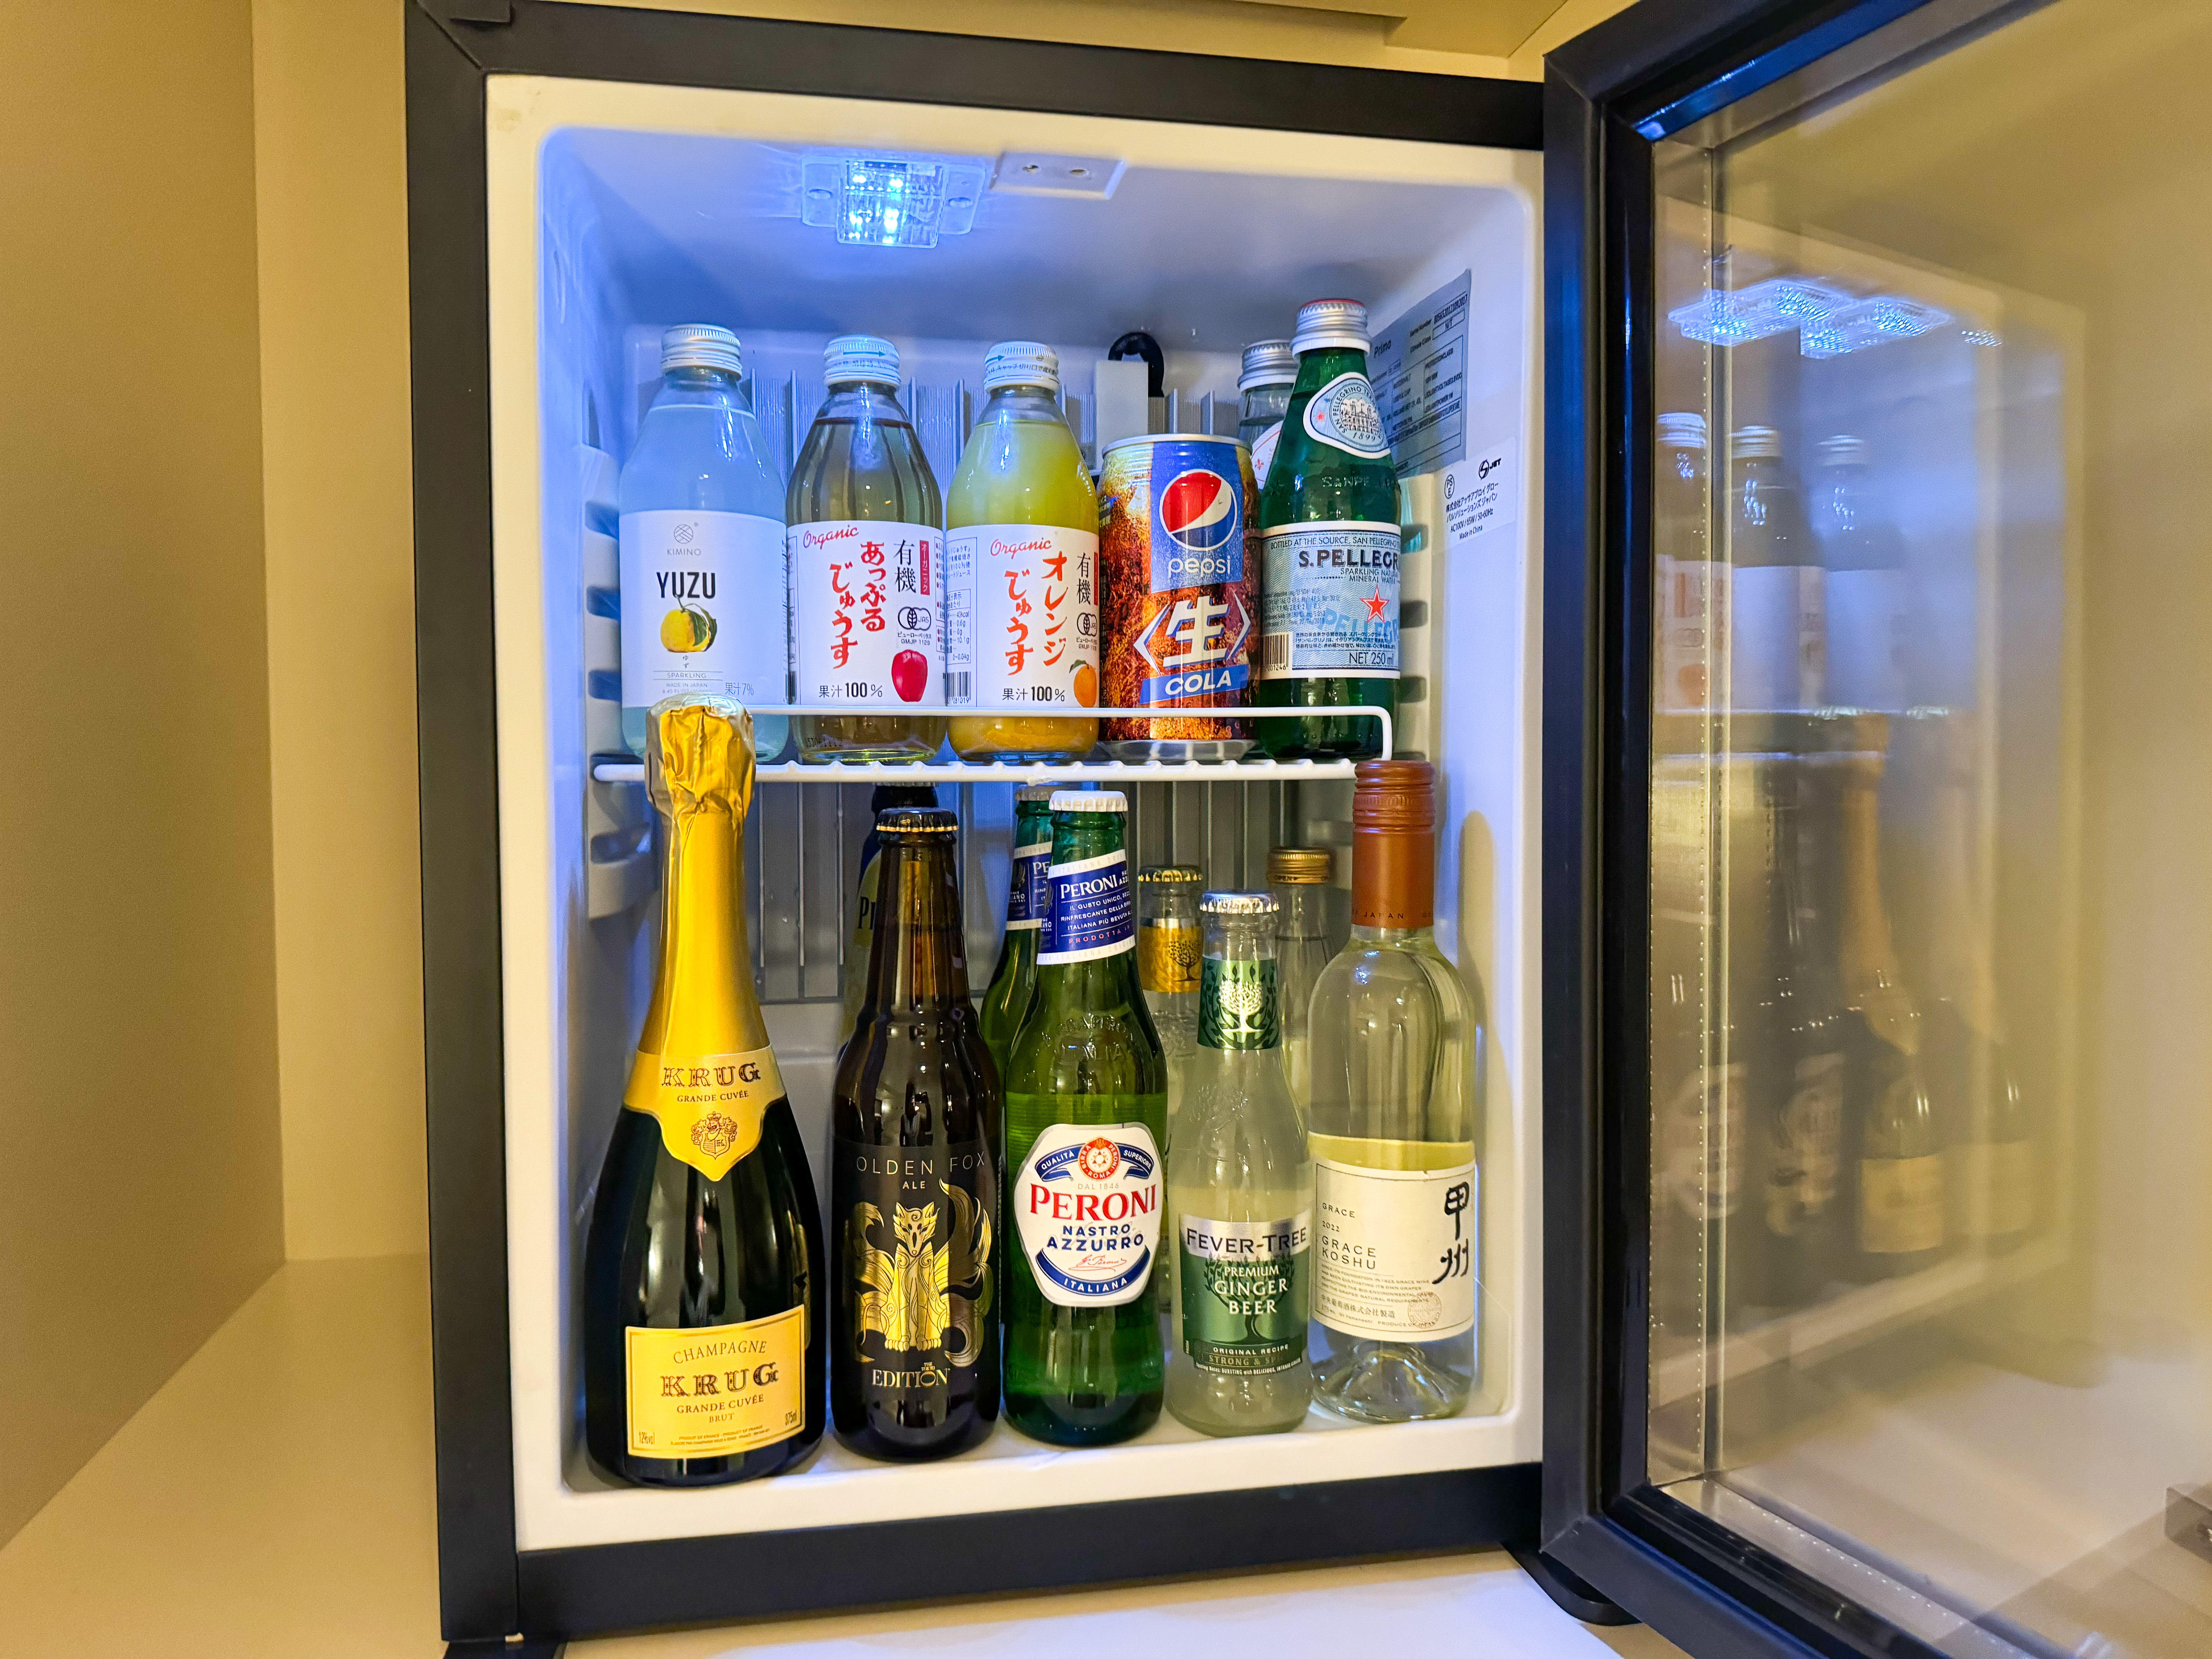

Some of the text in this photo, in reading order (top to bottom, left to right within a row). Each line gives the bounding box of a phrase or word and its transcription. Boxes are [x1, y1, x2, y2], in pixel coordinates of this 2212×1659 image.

[1374, 340, 1391, 359] Primo
[1333, 386, 1361, 433] SAN PELLEGRINO
[1353, 432, 1375, 441] 1899
[1489, 458, 1501, 469] JET
[803, 525, 859, 550] Organic
[990, 537, 1052, 559] Organic
[893, 539, 916, 593] 有機
[1168, 556, 1231, 578] pepsi
[656, 572, 716, 599] YUZU
[860, 541, 886, 632] あっぷる
[1077, 552, 1091, 605] 有機
[830, 561, 858, 670] じゅうす
[1041, 551, 1068, 667] オレンジ
[1004, 568, 1034, 676] じゅうす
[1164, 595, 1230, 668] 生
[683, 655, 689, 669] ゆず
[1349, 652, 1394, 665] NET 250 ml
[1165, 670, 1232, 696] COLA
[1060, 874, 1118, 899] PERONI
[1061, 908, 1108, 922] RINFRESCANTE
[1109, 904, 1123, 913] DELLA
[1078, 901, 1101, 910] GUSTO
[1363, 911, 1404, 920] JAPAN
[1068, 921, 1097, 931] ITALIANA
[1099, 917, 1109, 926] PIÙ
[1111, 913, 1128, 922] BEVUTA
[1068, 929, 1121, 944] PRODOTTA
[661, 1062, 761, 1088] KRUG
[677, 1090, 749, 1102] GRANDE CUVÉE
[856, 1151, 984, 1176] OLDEN FOX
[1041, 1144, 1152, 1171] QUALITÀ BIRRA PERONI SUPERIORE
[902, 1180, 926, 1189] ALE
[1087, 1171, 1111, 1179] ROMA
[1030, 1182, 1156, 1221] PERONI
[1322, 1202, 1355, 1218] GRACE
[1063, 1223, 1130, 1237] NASTRO
[1322, 1220, 1340, 1233] 2022
[1432, 1181, 1470, 1285] 甲州
[1046, 1233, 1144, 1252] AZZURRO
[1187, 1226, 1306, 1254] FEVER-TREE
[1322, 1235, 1376, 1258] GRACE
[1322, 1247, 1376, 1270] KOSHU
[1224, 1265, 1279, 1277] PREMIUM
[1341, 1271, 1373, 1281] FOUNDATION
[1063, 1277, 1128, 1292] ITALIANA
[1214, 1278, 1288, 1297] GINGER
[1229, 1299, 1278, 1316] BEER
[673, 1340, 767, 1364] CHAMPAGNE
[1213, 1344, 1289, 1355] ORIGINAL RECIPE
[1209, 1355, 1249, 1366] STRONG
[660, 1362, 779, 1397] KRUG
[872, 1368, 950, 1388] EDITION
[677, 1394, 764, 1414] GRANDE CUVÉE
[709, 1412, 734, 1422] BRUT
